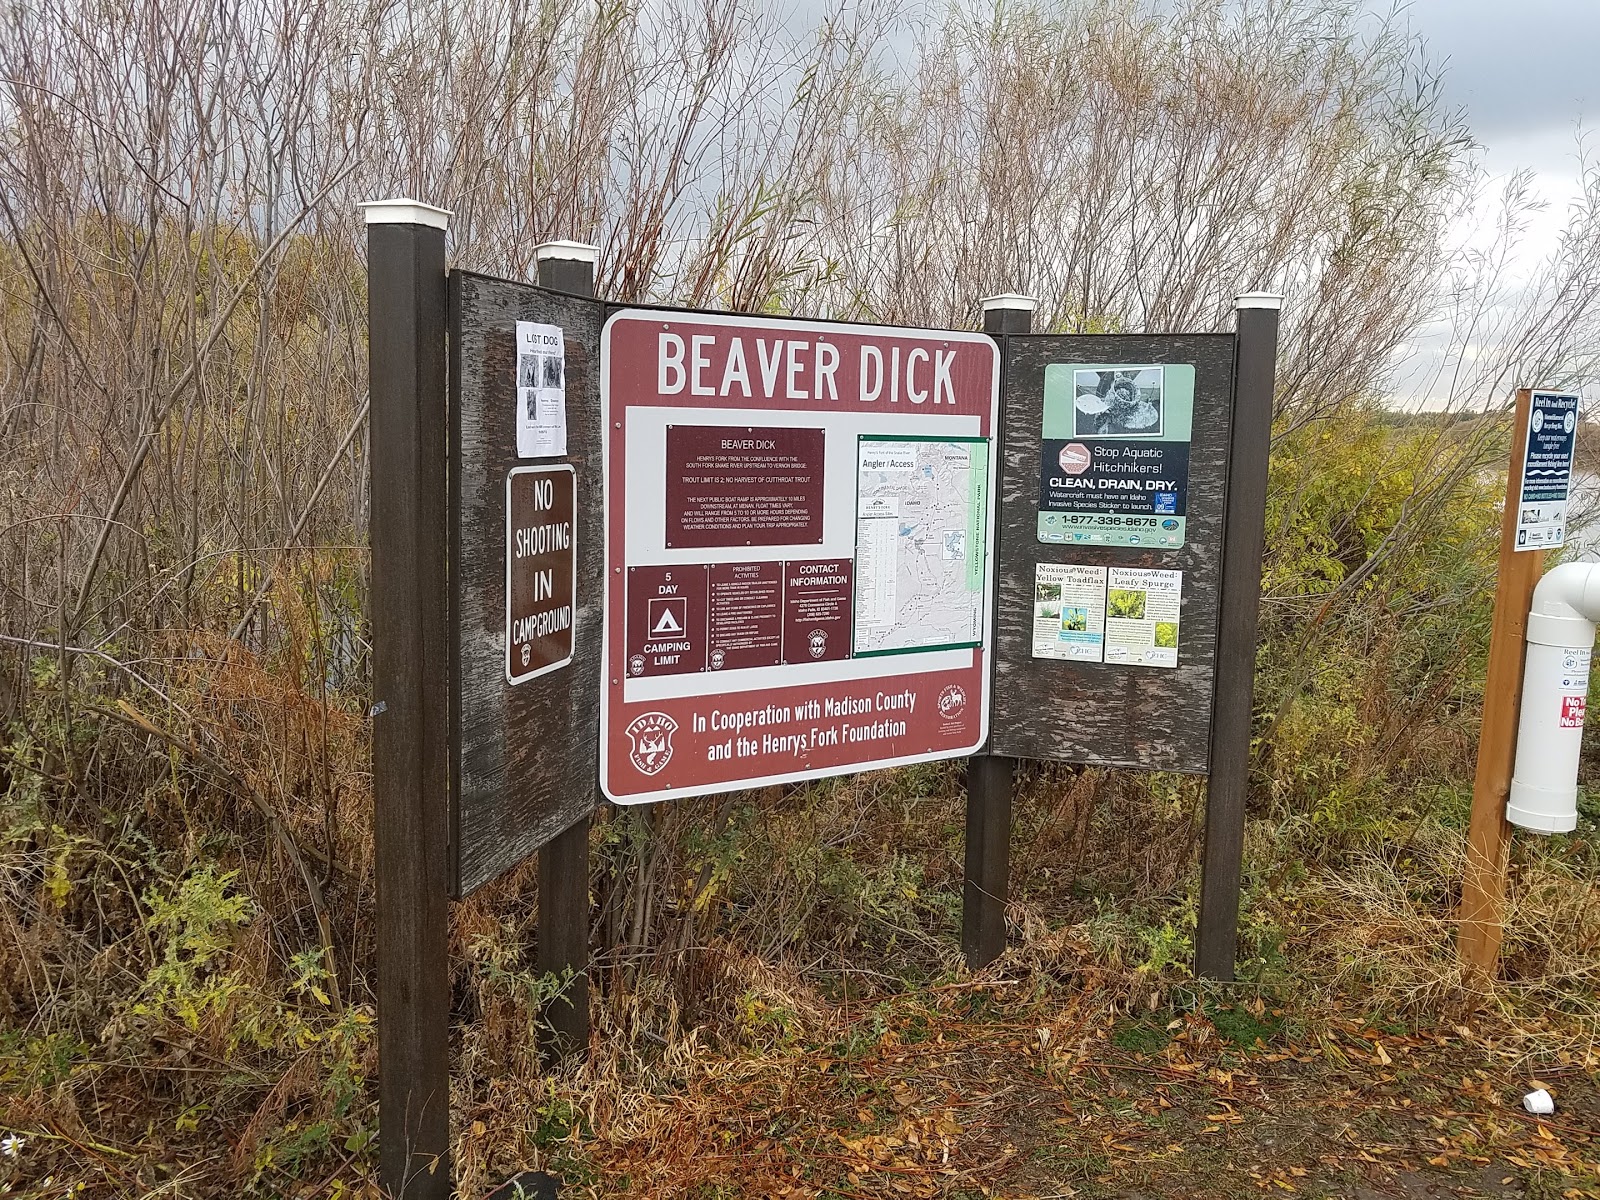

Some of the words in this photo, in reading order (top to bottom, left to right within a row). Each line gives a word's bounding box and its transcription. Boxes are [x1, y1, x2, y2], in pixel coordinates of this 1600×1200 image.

[544, 336, 558, 345] DOG
[658, 332, 840, 400] BEAVER
[859, 344, 957, 404] DICK
[1535, 397, 1546, 407] Reel
[721, 439, 754, 450] BEAVER
[756, 440, 776, 450] DICK
[1094, 446, 1119, 460] Stop
[1122, 447, 1163, 460] Aquatic
[862, 459, 886, 469] Angler
[890, 459, 914, 467] Access
[1093, 462, 1162, 474] Hitchhikers!
[1049, 477, 1096, 490] CLEAN,
[1098, 479, 1143, 491] DRAIN,
[1145, 480, 1178, 491] DRY.
[534, 479, 553, 512] NO
[1049, 491, 1084, 499] Watercraft
[1073, 501, 1097, 509] Species
[1061, 515, 1157, 527] 1-877-336-8676
[516, 522, 569, 559] SHOOTING
[800, 564, 839, 574] CONTACT
[1039, 565, 1073, 574] Noxious
[1076, 567, 1102, 575] Weed:
[1112, 569, 1147, 577] Noxious
[1150, 570, 1178, 578] Weed:
[665, 572, 672, 581] 5
[790, 576, 847, 587] INFORMATION
[1036, 574, 1064, 582] Yellow
[1067, 576, 1104, 585] Toadflax
[534, 568, 552, 602] IN
[1114, 578, 1139, 587] Leafy
[1142, 580, 1174, 588] Spurge
[658, 585, 678, 594] DAY
[513, 605, 571, 645] CAMPGROUND
[643, 641, 691, 653] CAMPING
[654, 655, 680, 665] LIMIT
[1566, 698, 1579, 706] No
[693, 712, 706, 733] In
[711, 703, 792, 733] Cooperation
[794, 699, 821, 720] with
[824, 693, 872, 717] Madison
[876, 689, 917, 715] County
[632, 716, 673, 734] IDAHO
[1561, 717, 1574, 727] No
[708, 740, 733, 762] and
[736, 737, 757, 757] the
[763, 729, 808, 757] Henrys
[811, 725, 838, 749] Fork
[842, 719, 907, 744] Foundation
[634, 754, 647, 769] FISH
[655, 750, 671, 769] GAME
